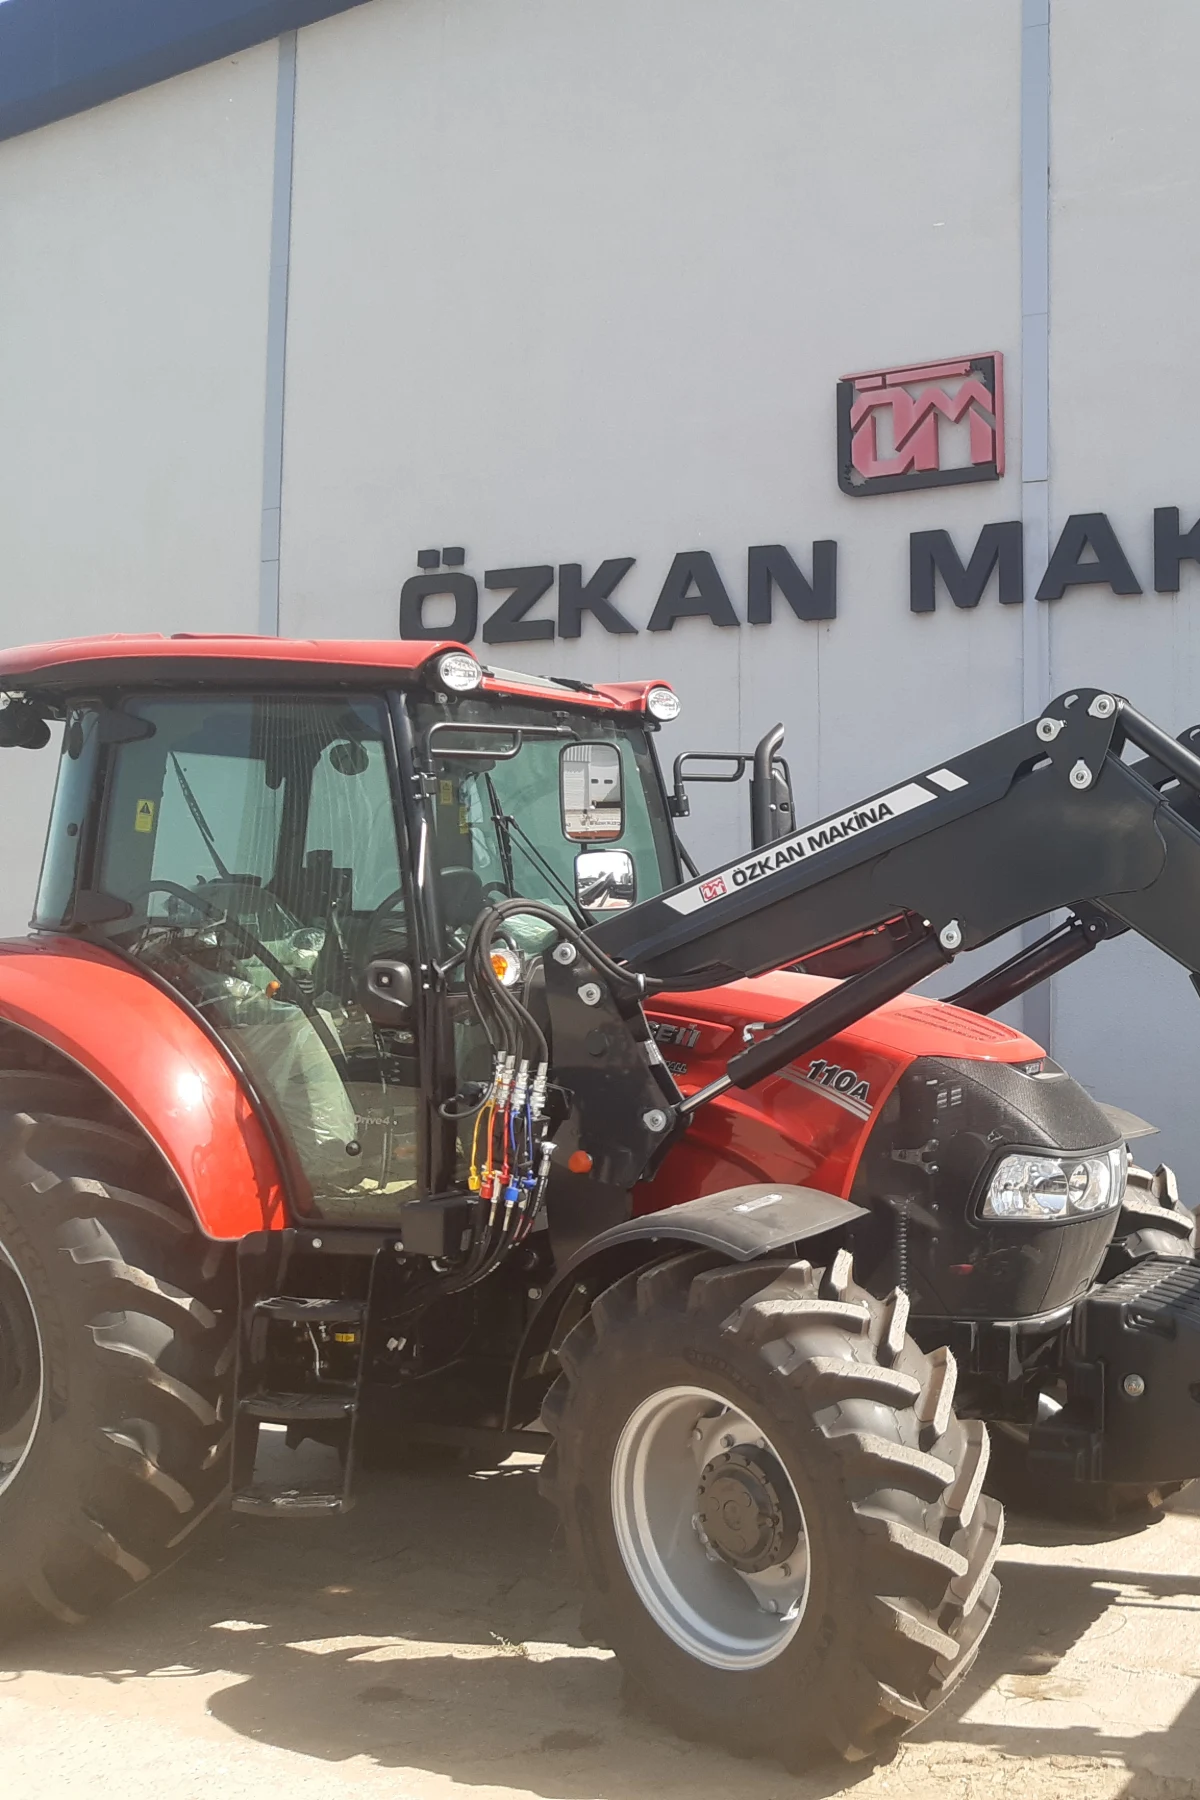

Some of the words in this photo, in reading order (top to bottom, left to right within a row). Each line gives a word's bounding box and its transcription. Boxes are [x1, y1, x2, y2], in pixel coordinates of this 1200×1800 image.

[399, 540, 838, 644] ÖZKAN
[731, 842, 805, 887] ÖZKAN
[806, 802, 895, 853] MAKİNA
[807, 1059, 870, 1102] 110A
